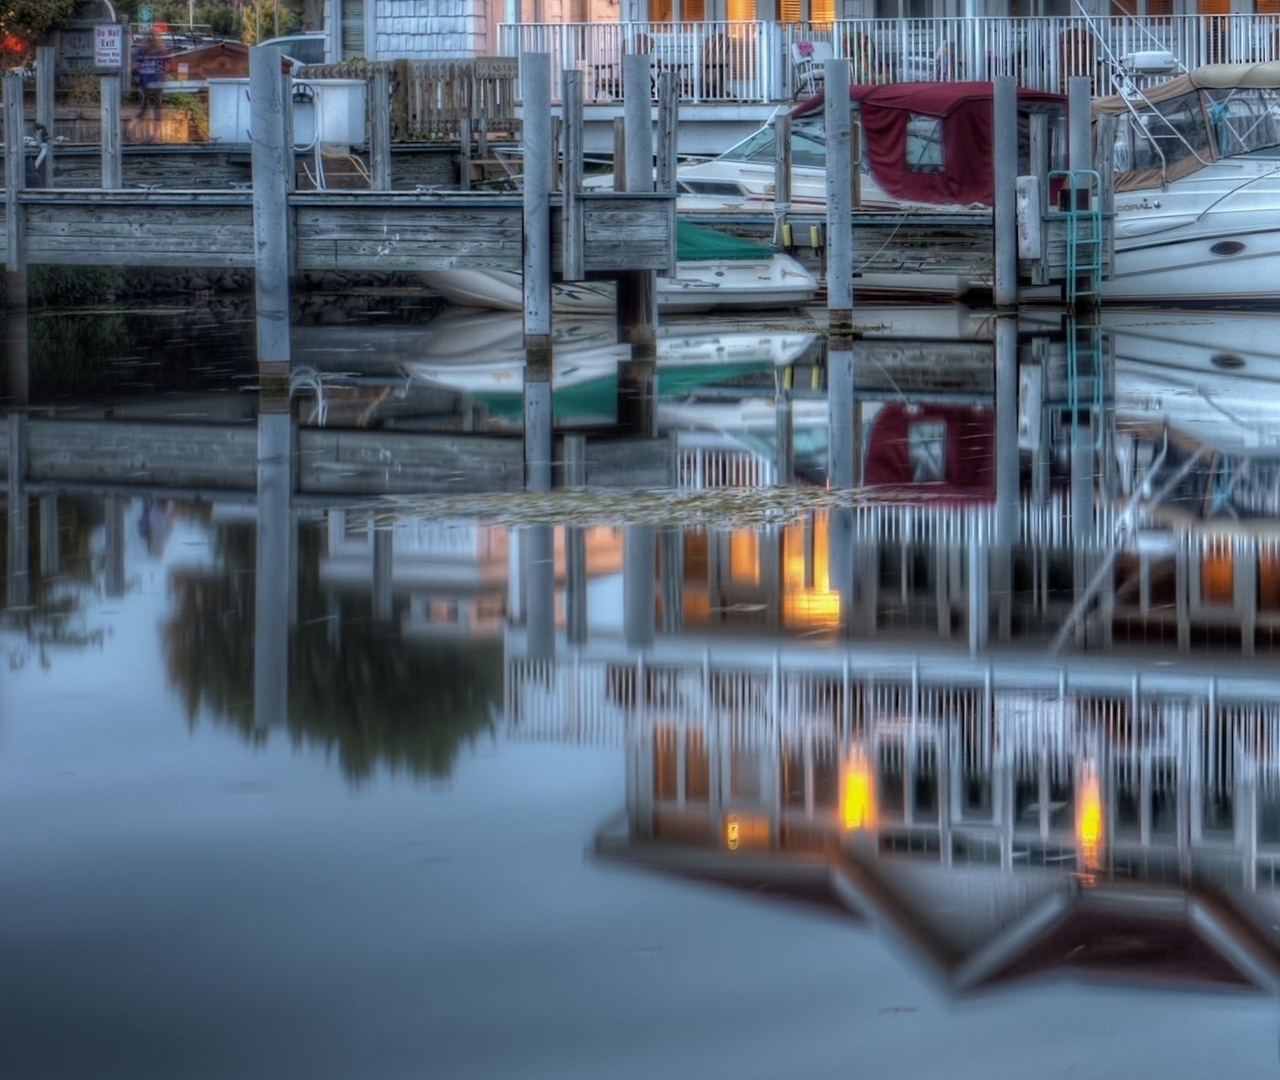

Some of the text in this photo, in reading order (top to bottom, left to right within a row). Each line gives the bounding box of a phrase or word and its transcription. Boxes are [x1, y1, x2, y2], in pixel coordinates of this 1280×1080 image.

[96, 28, 120, 37] Do Not
[101, 38, 115, 47] Exit
[1116, 203, 1153, 212] DORAL
